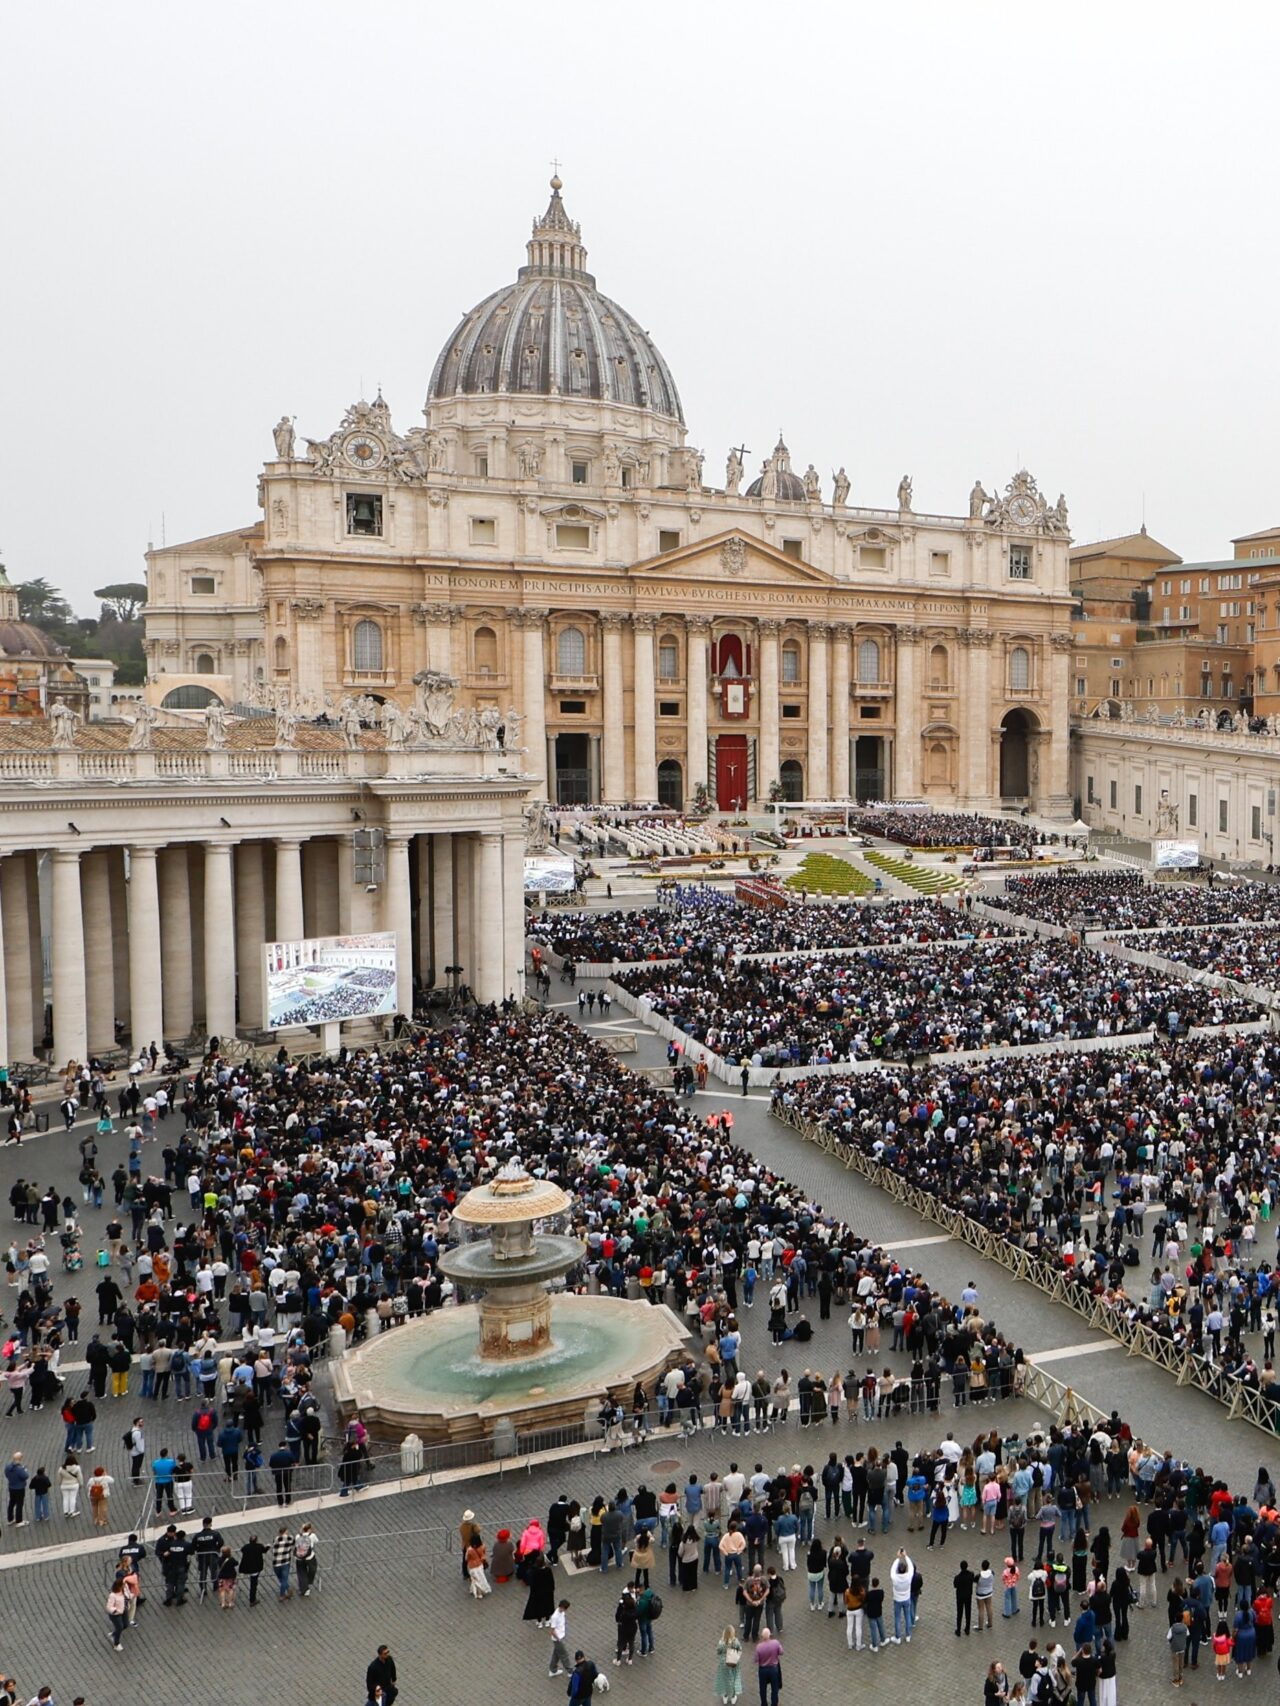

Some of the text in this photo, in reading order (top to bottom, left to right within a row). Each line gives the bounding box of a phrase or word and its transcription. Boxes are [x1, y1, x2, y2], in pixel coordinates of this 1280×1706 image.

[427, 575, 444, 585] IN
[448, 577, 520, 590] HONOREM
[768, 593, 827, 604] ROMANVS
[972, 604, 988, 614] VII
